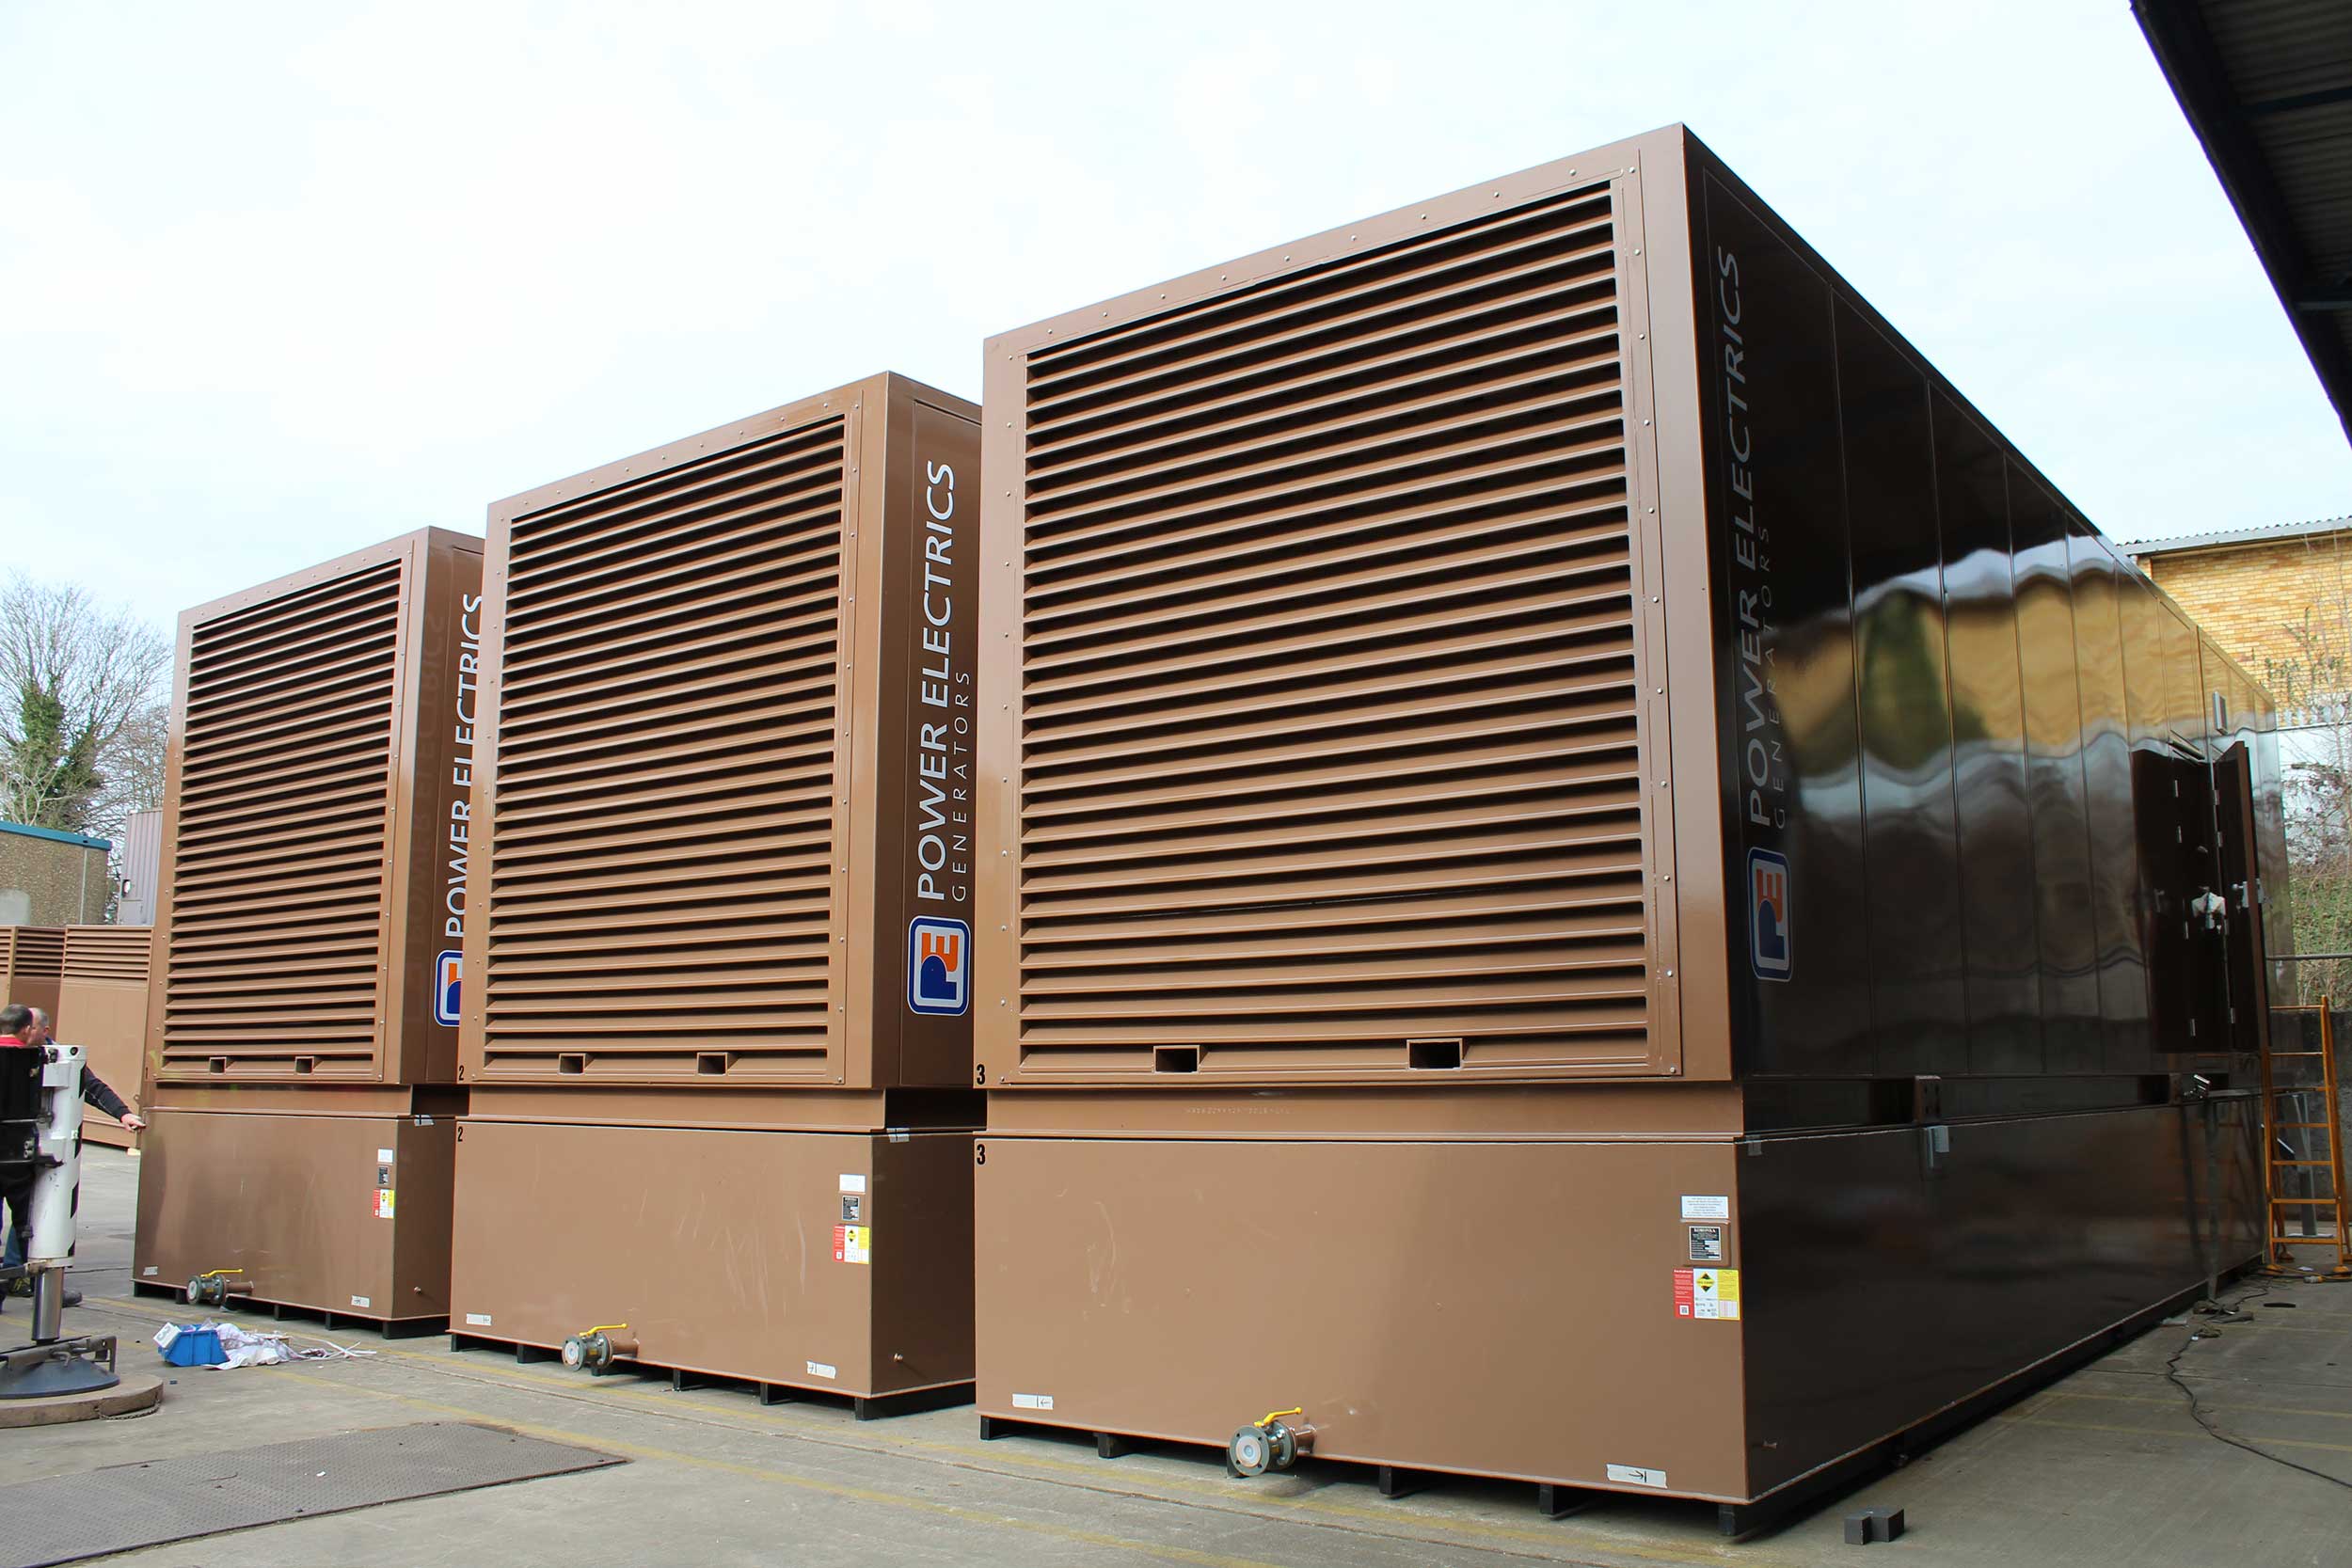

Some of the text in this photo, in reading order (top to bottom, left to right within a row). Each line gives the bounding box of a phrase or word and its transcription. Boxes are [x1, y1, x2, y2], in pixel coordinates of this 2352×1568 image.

[1717, 245, 1772, 827] POWER ELECTRICS
[917, 460, 954, 900] POWER ELECTRICS
[1758, 526, 1787, 830] GENERATORS
[951, 672, 970, 902] GENERATORS
[445, 800, 470, 938] POWER
[457, 1126, 464, 1142] 2
[458, 1065, 465, 1081] 2
[976, 1063, 986, 1085] 3
[976, 1144, 986, 1165] 3
